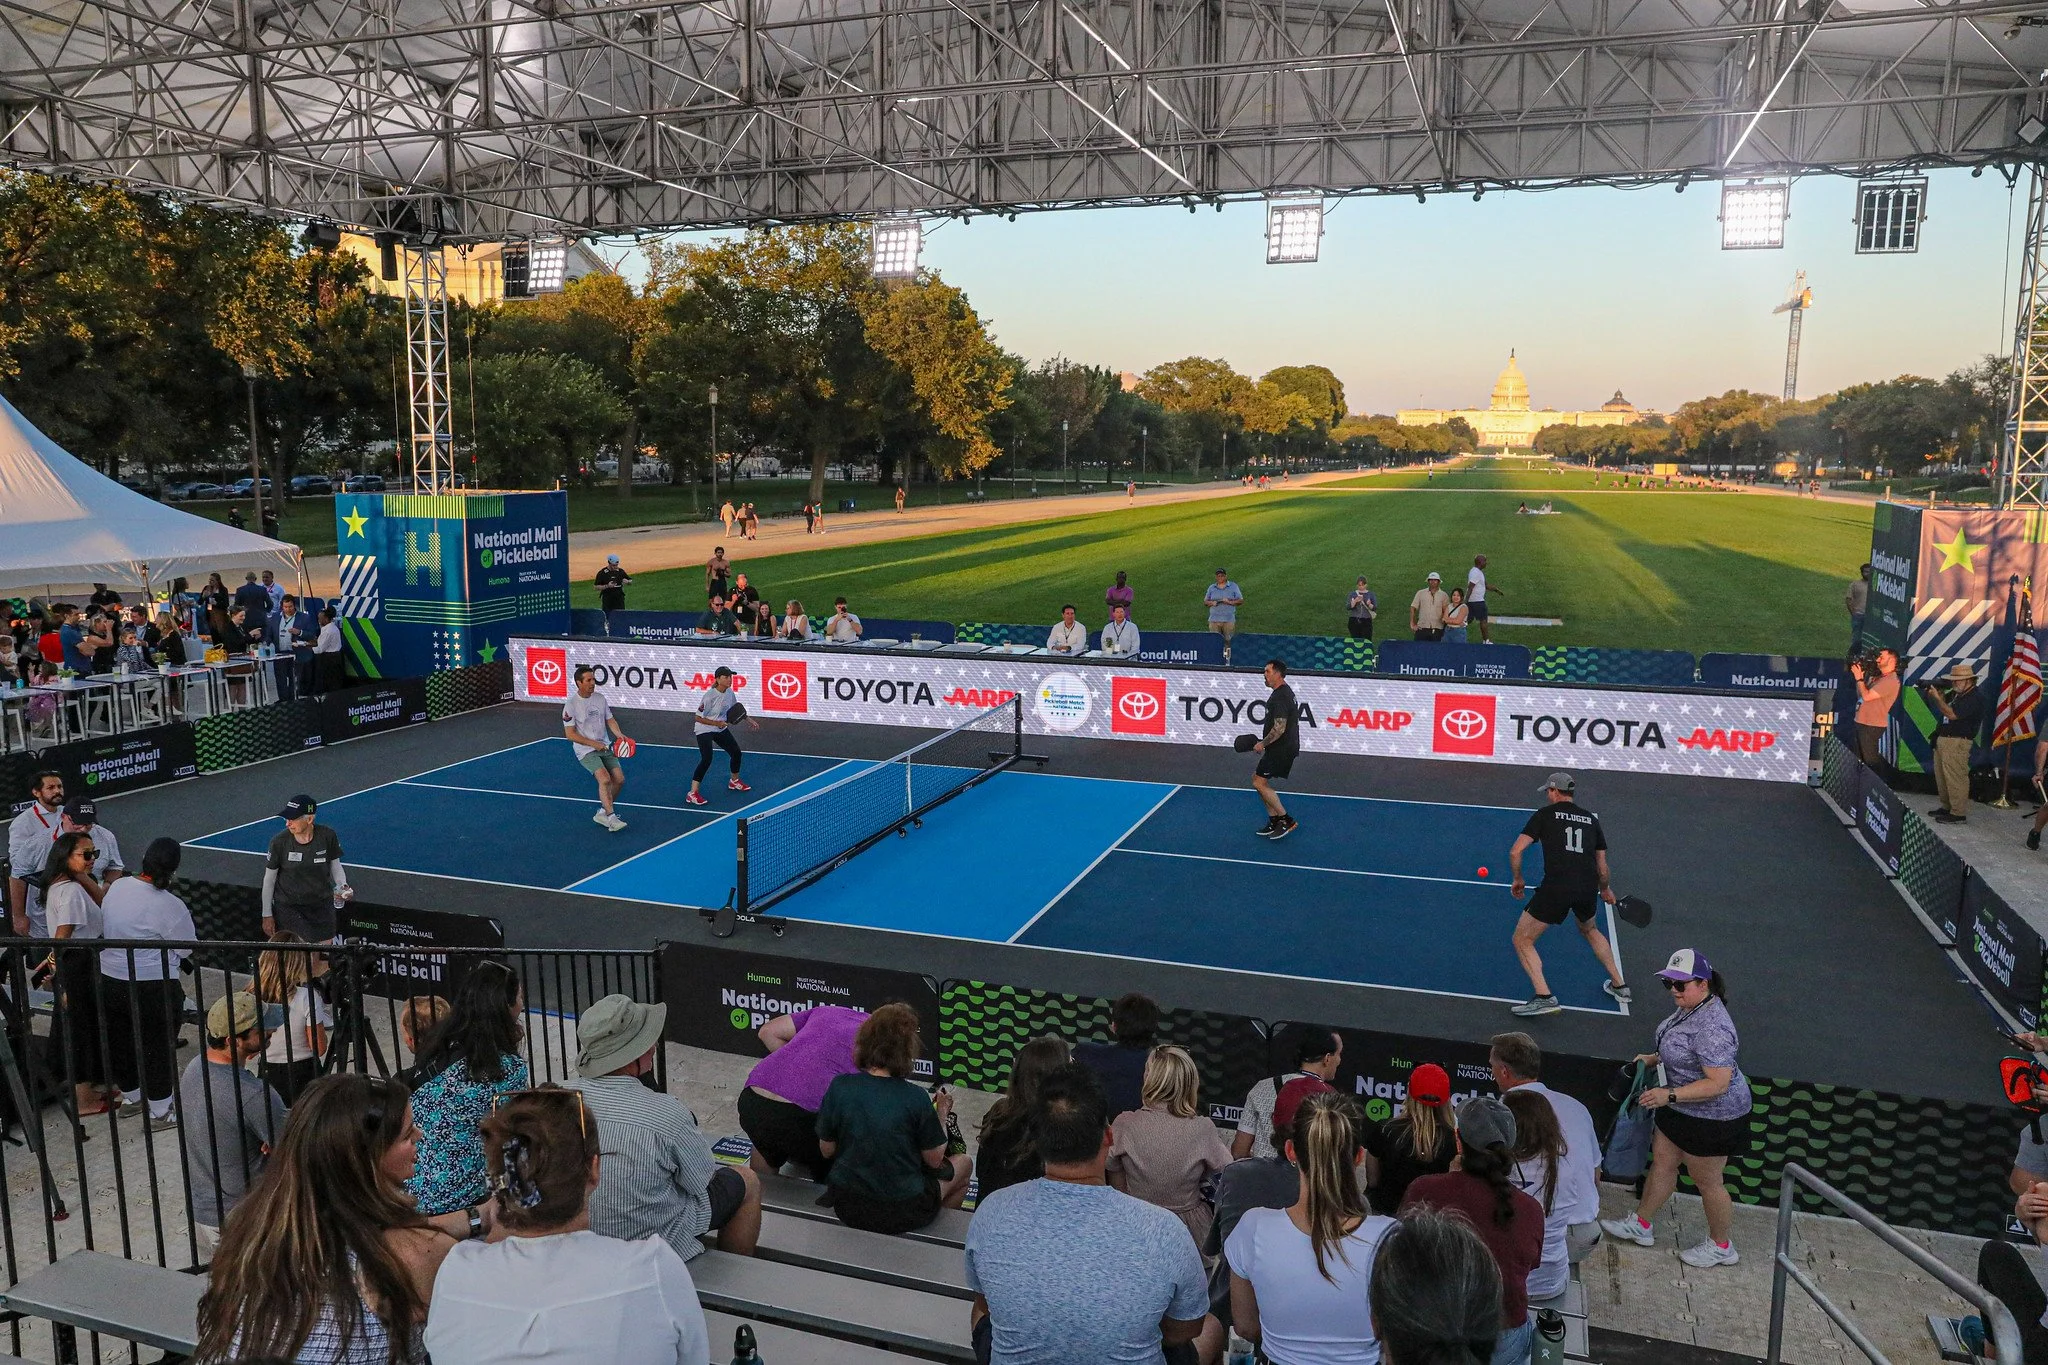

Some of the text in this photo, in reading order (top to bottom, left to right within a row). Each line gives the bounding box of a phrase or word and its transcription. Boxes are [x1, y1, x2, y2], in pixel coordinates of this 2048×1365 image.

[474, 526, 561, 549] National Mall
[494, 544, 557, 565] Pickleball
[1872, 548, 1911, 580] National Mall
[1877, 573, 1906, 603] Pickleball
[629, 626, 695, 636] National Mall
[1171, 650, 1198, 660] Mall
[1400, 664, 1455, 675] Humana
[684, 673, 747, 692] AAP
[1731, 674, 1838, 690] National Mall
[818, 677, 935, 706] TOYOTA
[943, 688, 1017, 708] AARP
[348, 698, 402, 717] National Mall
[360, 708, 399, 723] Pickleball
[1178, 696, 1317, 728] TOYOA
[1327, 708, 1412, 731] AARP
[1510, 714, 1666, 749] TOYOTA
[1677, 728, 1776, 753] AARP
[81, 749, 160, 774] National Mall
[99, 761, 156, 782] Pickleball
[308, 805, 313, 813] H
[1555, 812, 1592, 825] PFLUGER
[1565, 827, 1584, 853] 11
[350, 919, 378, 930] Humana
[736, 914, 755, 922] OOLA
[390, 928, 433, 939] NATIONAL MALL
[1973, 915, 1999, 954] National
[1998, 944, 2016, 971] Mall
[747, 973, 781, 985] Humana
[796, 982, 850, 996] NATIONAL MALL
[722, 988, 813, 1014] National
[734, 1013, 745, 1023] of
[914, 1062, 931, 1072] OLA
[1370, 1104, 1385, 1115] of
[714, 1146, 750, 1155] Reserved
[722, 1142, 751, 1151] Seating
